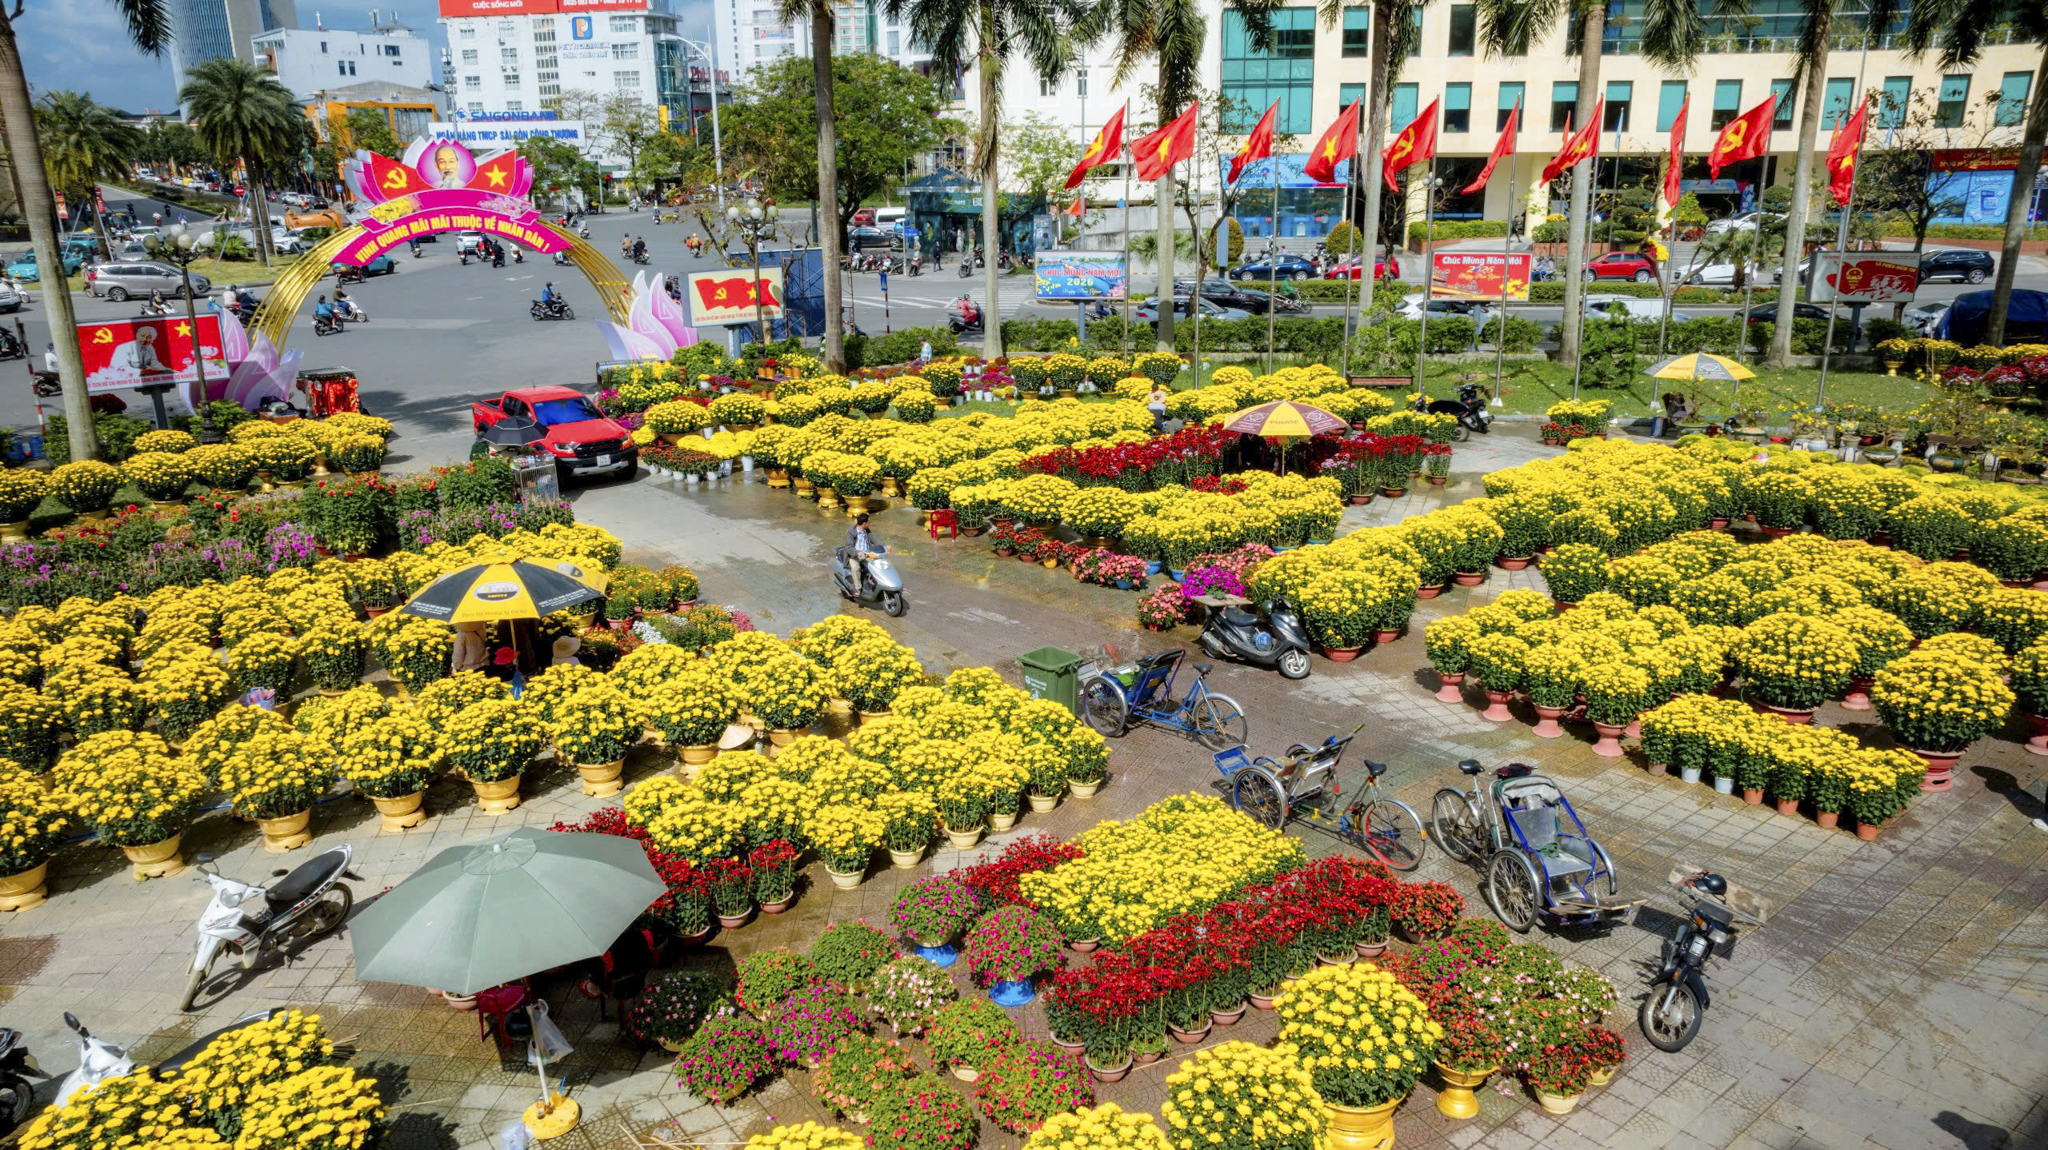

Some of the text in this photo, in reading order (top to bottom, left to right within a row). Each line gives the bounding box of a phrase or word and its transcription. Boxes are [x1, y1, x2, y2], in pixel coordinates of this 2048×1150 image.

[471, 110, 557, 121] SAIGONBANK
[478, 130, 498, 140] TMCP
[355, 240, 379, 263] VINH
[377, 225, 409, 247] QUANG
[409, 218, 430, 234] MÃI
[430, 214, 450, 230] MÃI
[451, 214, 482, 230] THUỘC
[484, 216, 496, 230] VỀ
[498, 220, 524, 238] NHÂN
[524, 230, 544, 248] DÂN
[1442, 256, 1460, 264] Chúc
[1487, 256, 1504, 264] Năm
[1067, 278, 1093, 286] 2026
